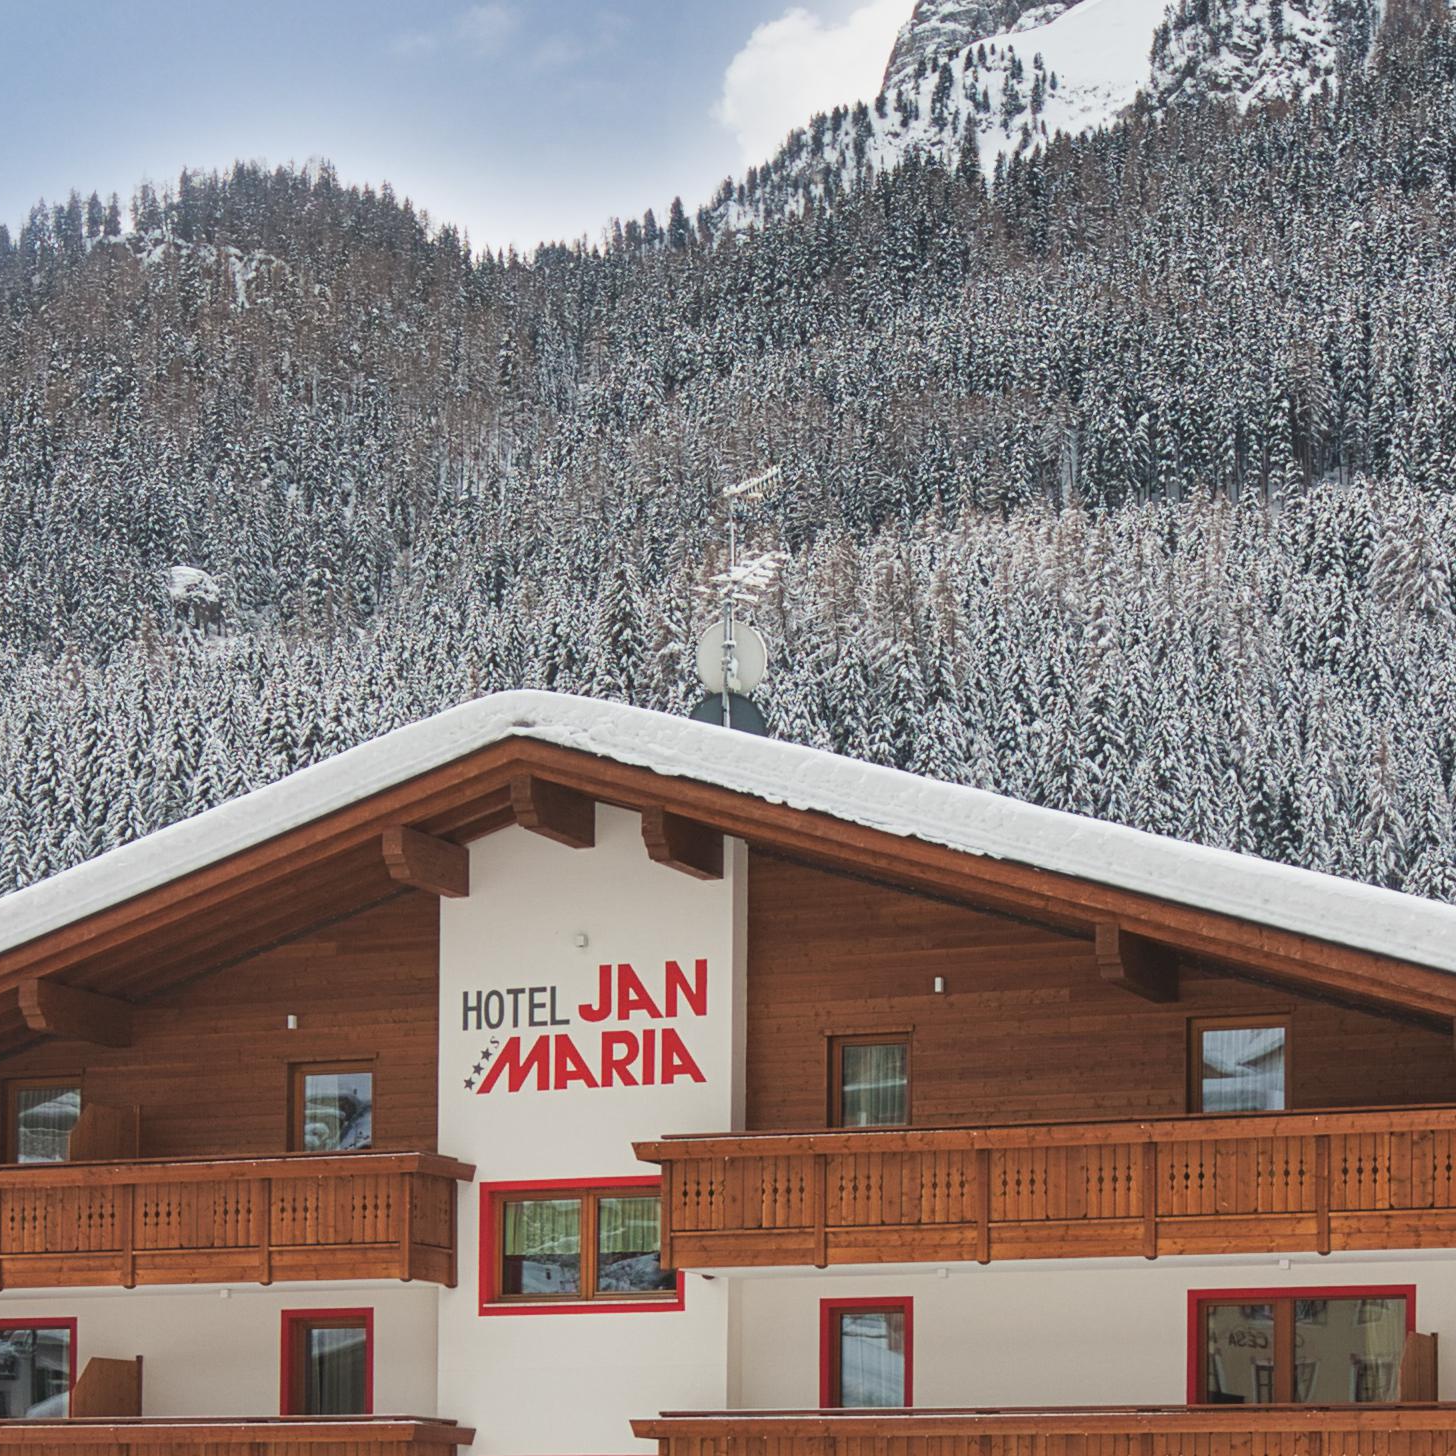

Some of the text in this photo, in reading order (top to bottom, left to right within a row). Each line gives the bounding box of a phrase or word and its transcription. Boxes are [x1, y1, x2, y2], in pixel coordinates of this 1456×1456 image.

[462, 959, 708, 1031] HOTEL JAN
[476, 1028, 706, 1095] MARIA
